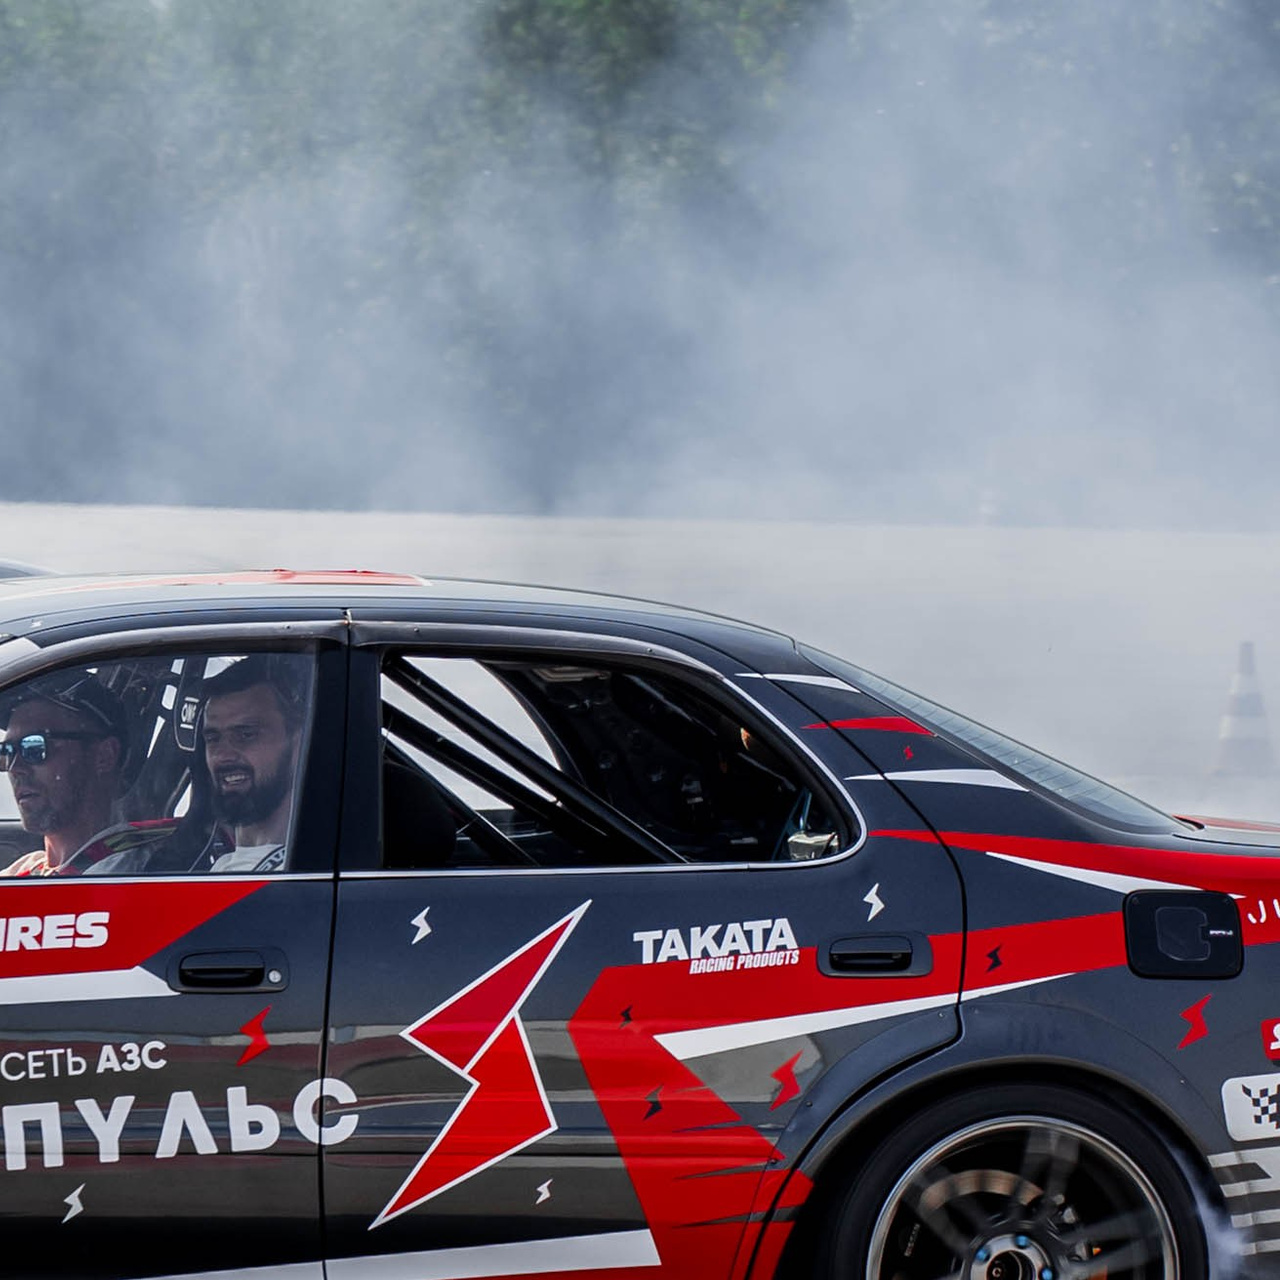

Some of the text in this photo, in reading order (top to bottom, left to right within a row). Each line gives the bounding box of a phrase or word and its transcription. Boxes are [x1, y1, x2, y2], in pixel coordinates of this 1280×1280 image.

[633, 918, 799, 965] TAKATA
[689, 949, 800, 975] RACING PRODUCTS
[1, 1041, 167, 1081] СЕТЬ АЗС
